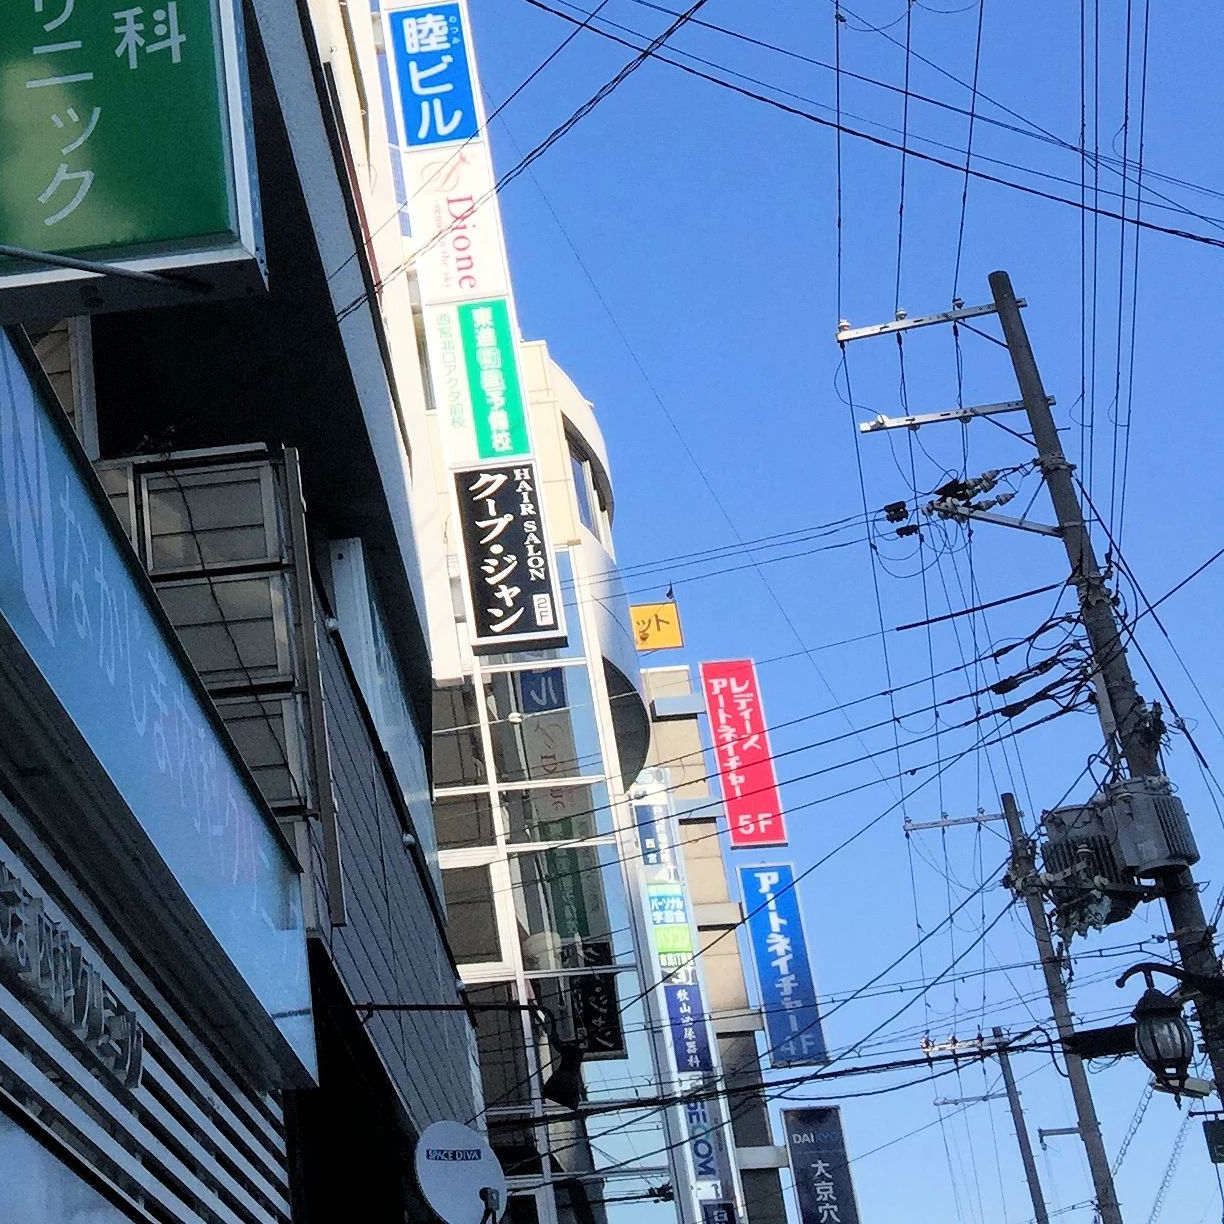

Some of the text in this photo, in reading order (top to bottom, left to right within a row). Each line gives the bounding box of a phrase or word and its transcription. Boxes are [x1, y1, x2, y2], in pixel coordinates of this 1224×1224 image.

[402, 13, 463, 139] 睦ビル
[446, 195, 477, 289] Dione
[468, 473, 525, 633] クープ・ジャン
[513, 468, 546, 581] HAIR SALON
[708, 678, 746, 800] アートネイチャー
[730, 677, 762, 751] レディース
[738, 812, 773, 835] 5F
[754, 872, 802, 1032] アートネイチャー
[781, 1035, 816, 1056] 4F
